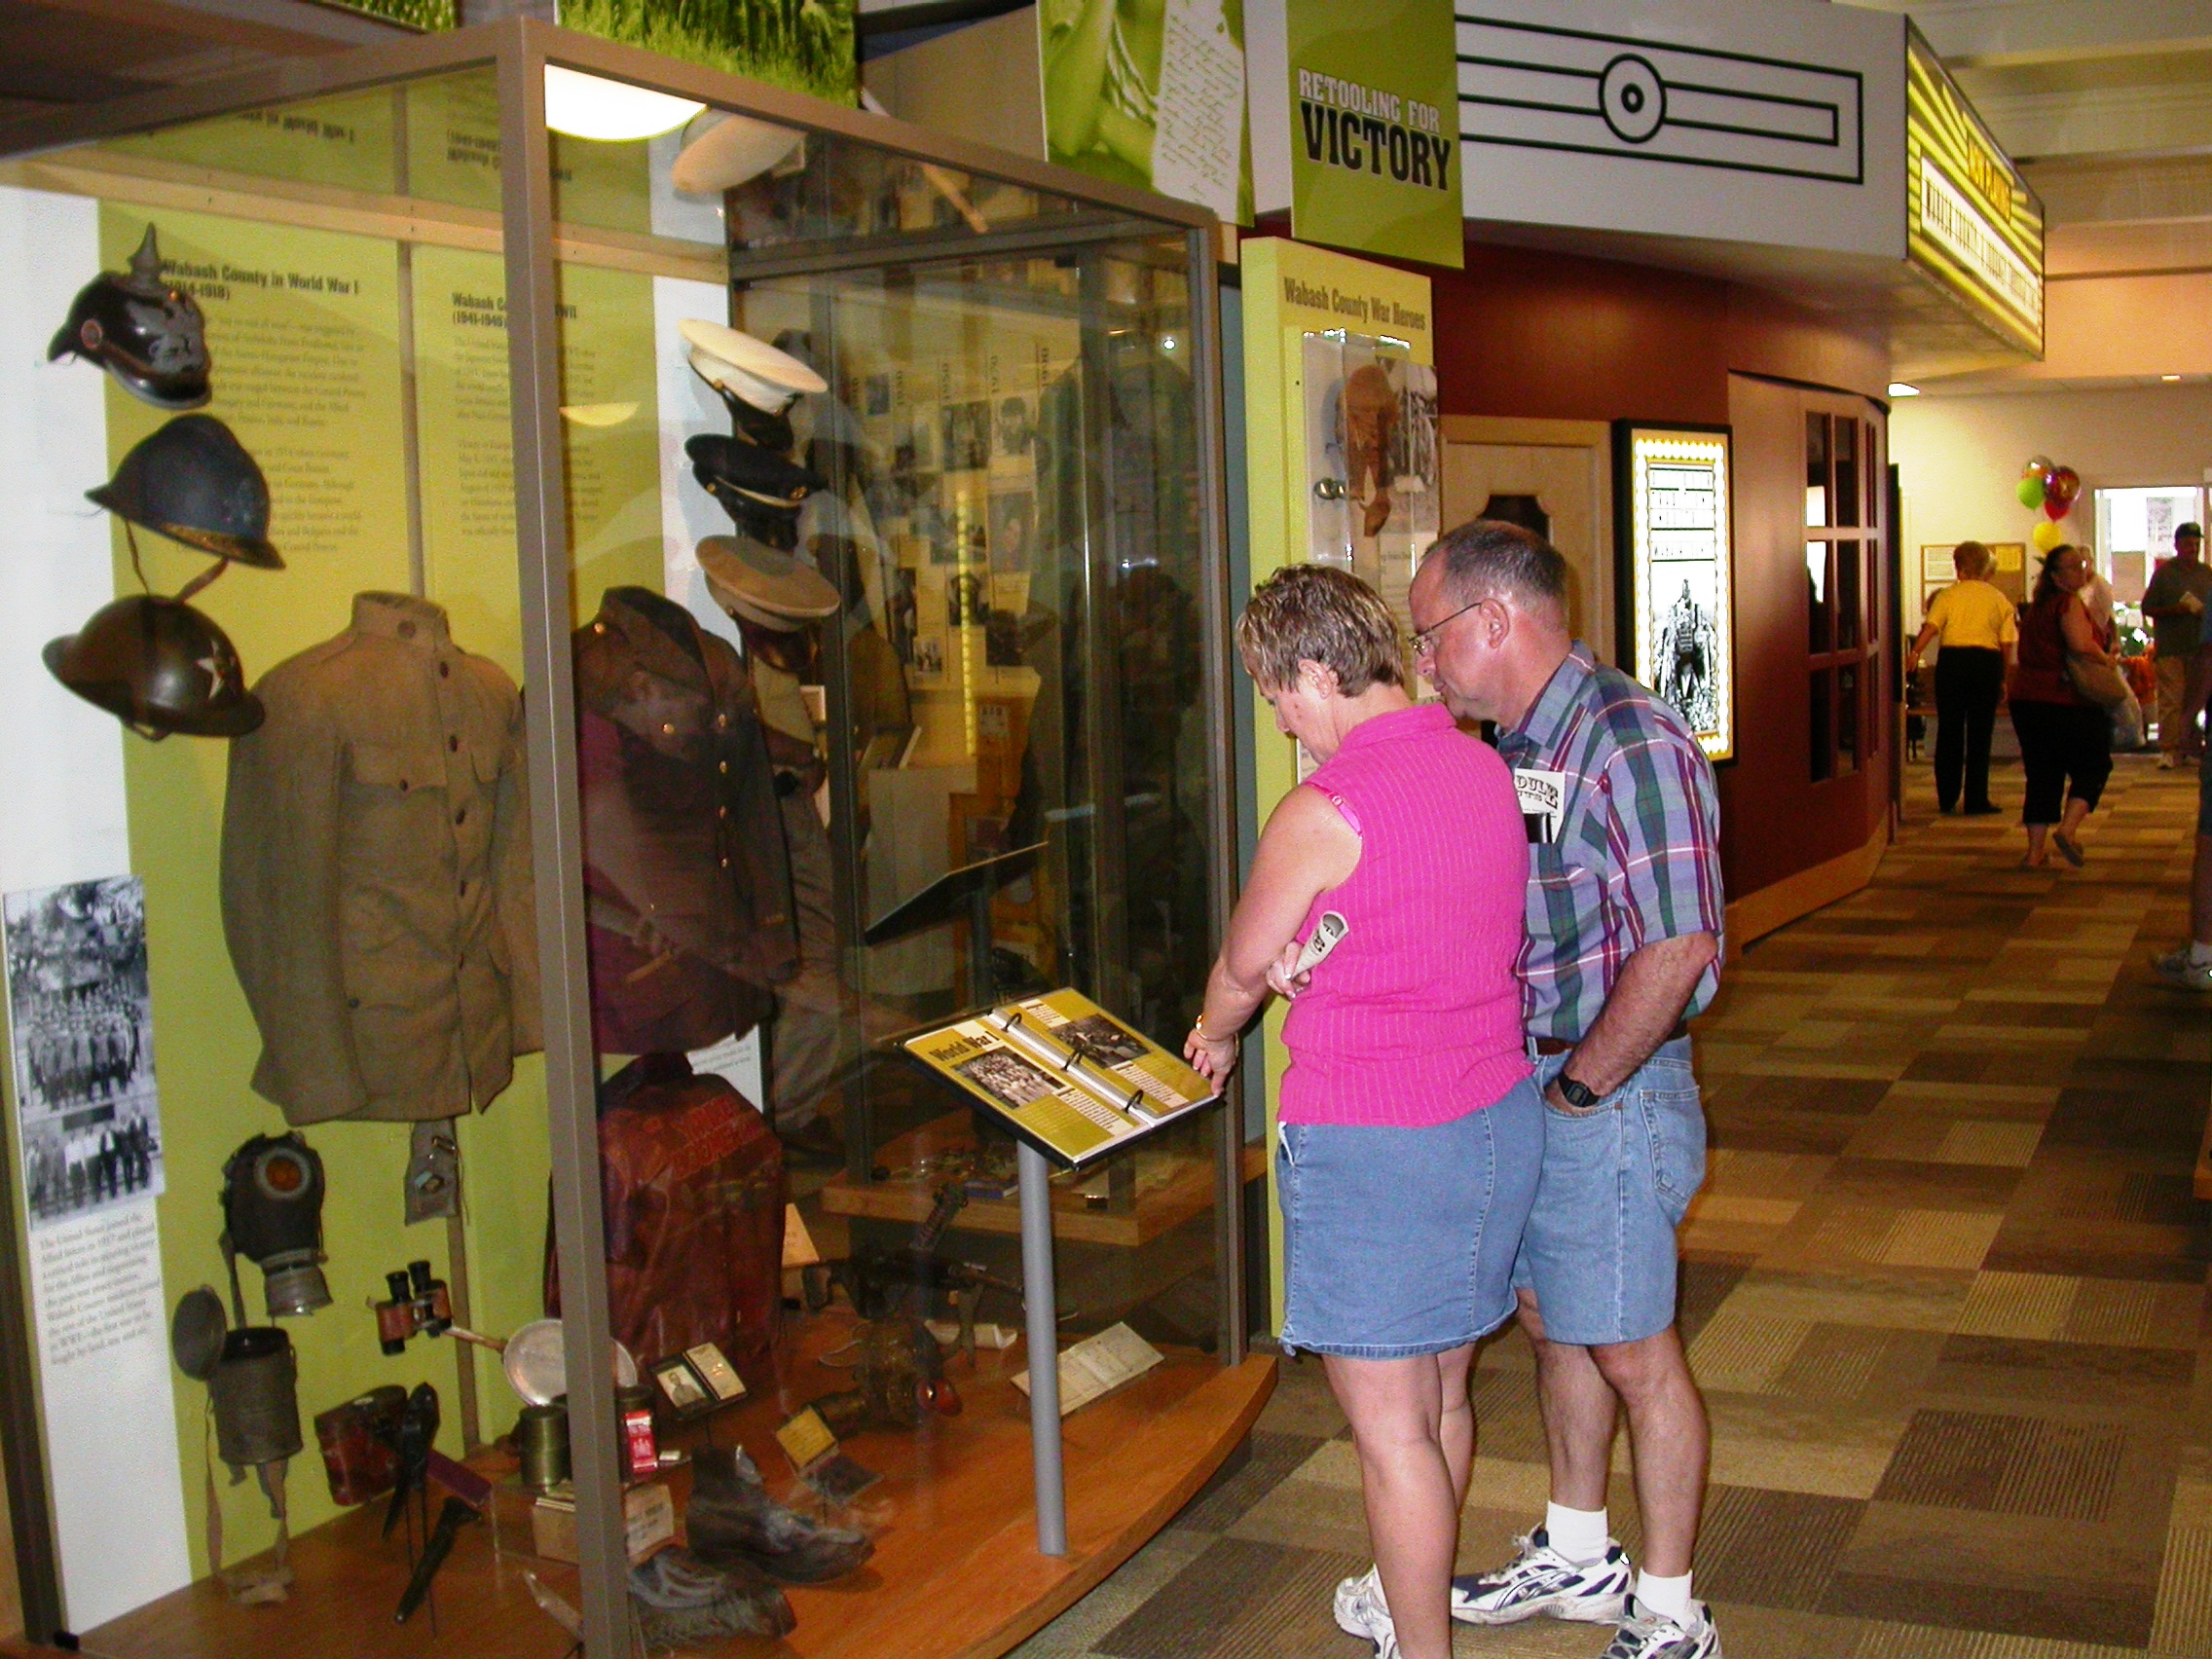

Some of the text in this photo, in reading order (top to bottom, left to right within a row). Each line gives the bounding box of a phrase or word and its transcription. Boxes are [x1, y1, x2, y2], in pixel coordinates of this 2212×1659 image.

[1299, 68, 1440, 133] RETOOLING FOR
[1301, 101, 1452, 191] VICTORY
[159, 259, 217, 279] Wabash
[221, 265, 268, 287] County
[272, 271, 283, 286] in
[287, 273, 323, 290] World
[326, 276, 350, 293] War
[452, 292, 494, 310] Wabash
[1284, 276, 1426, 331] Wabash County War Heroes
[929, 1041, 971, 1062] World
[963, 1035, 993, 1049] War
